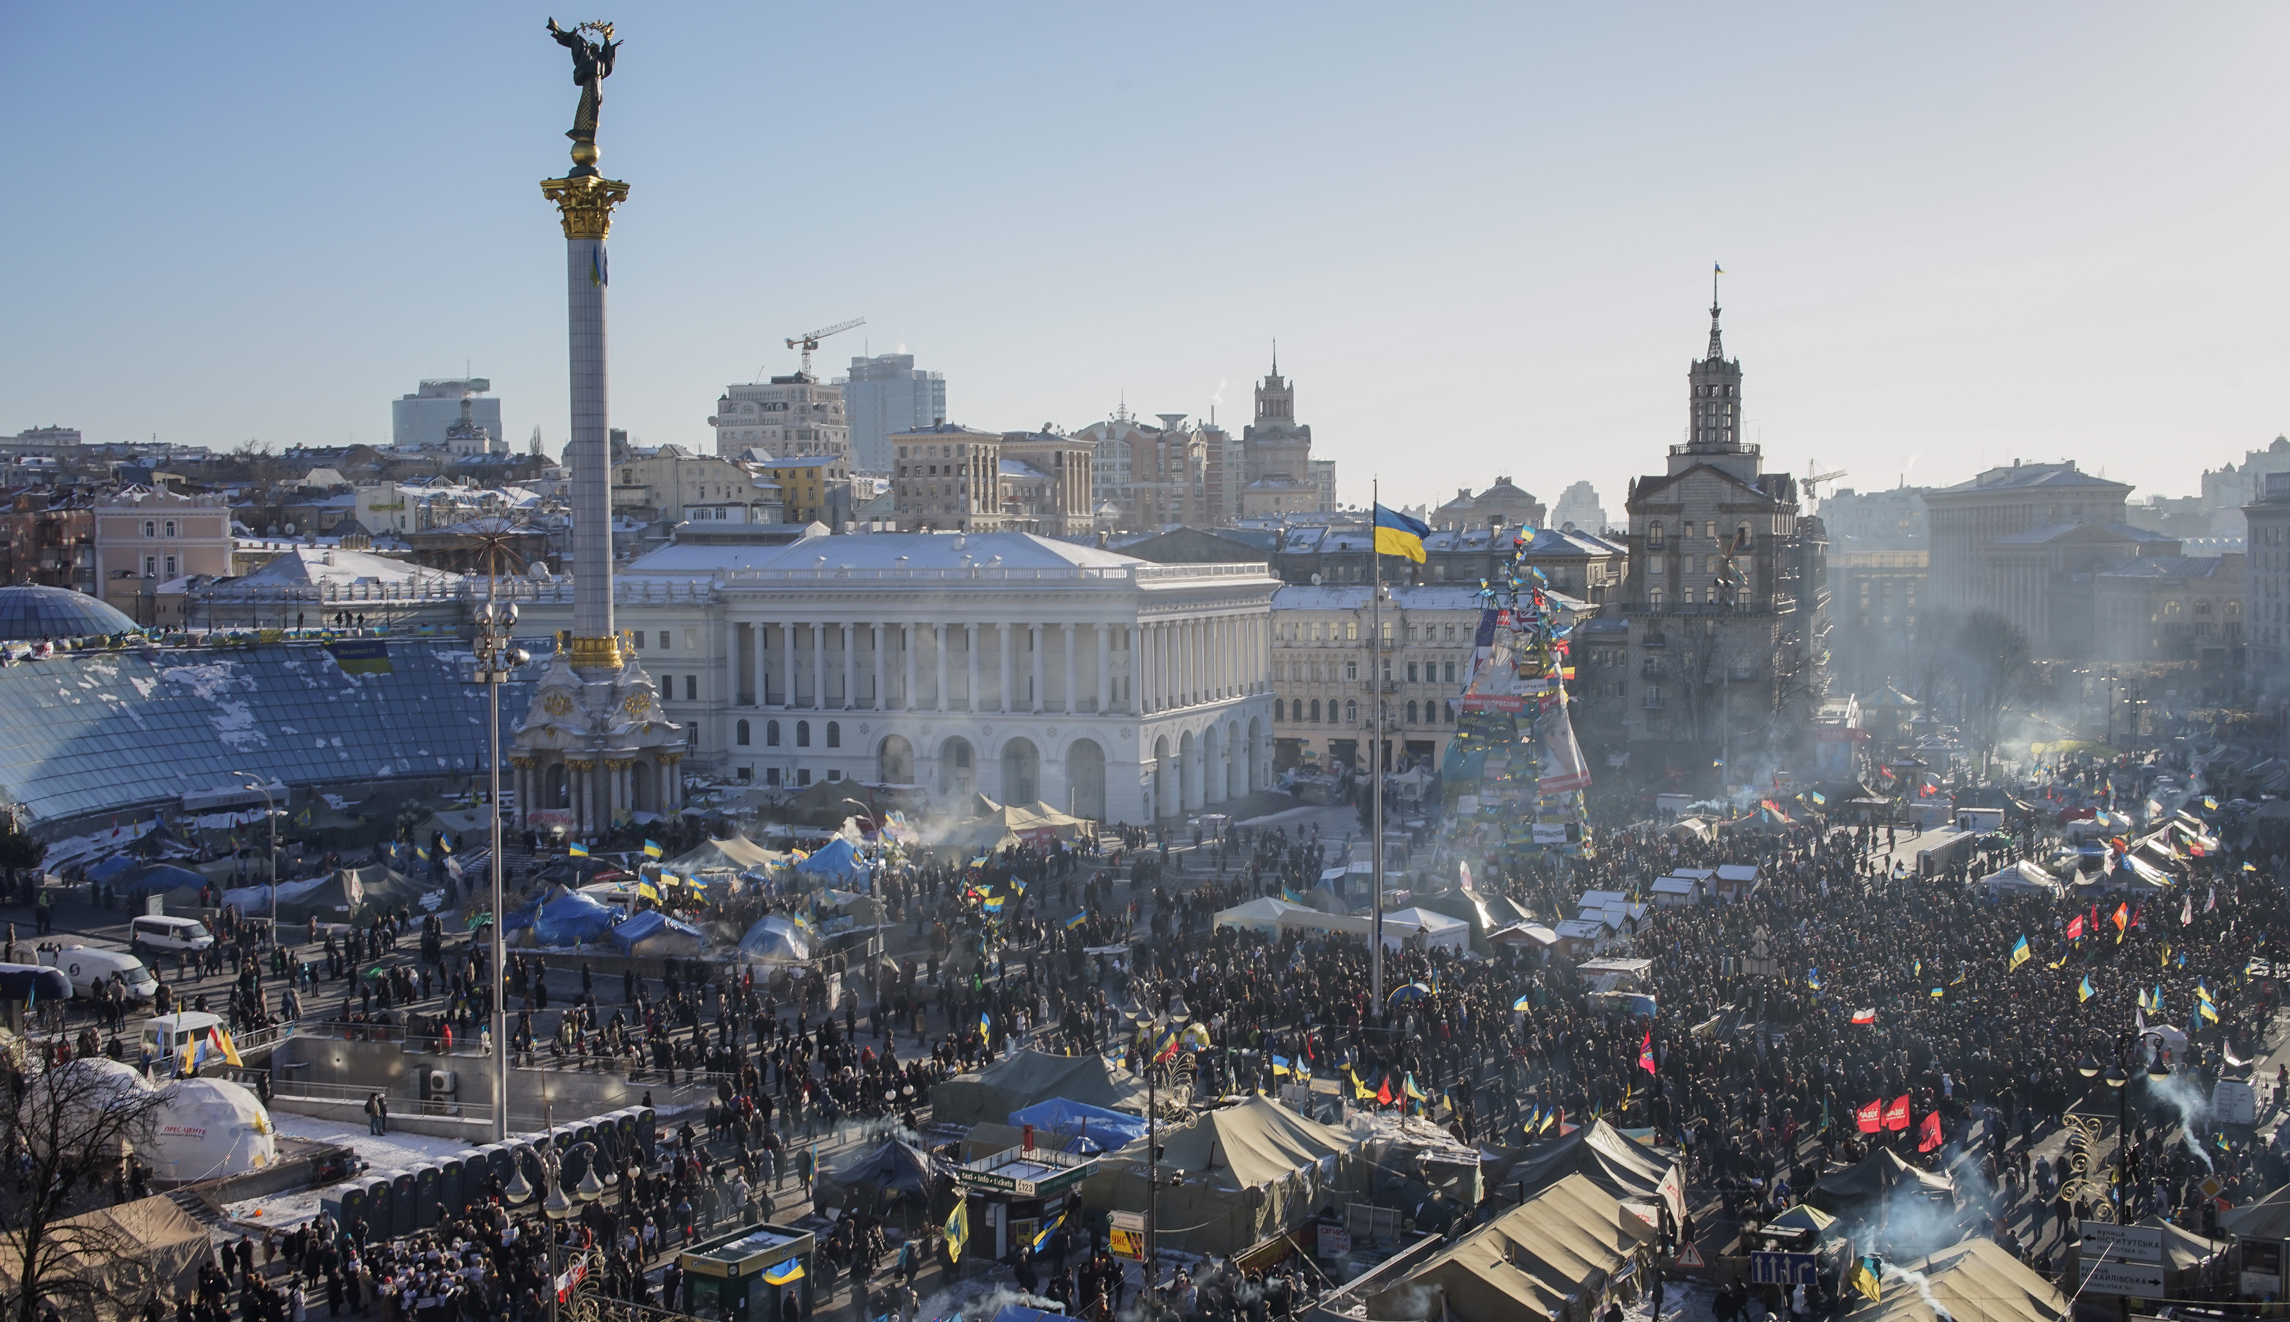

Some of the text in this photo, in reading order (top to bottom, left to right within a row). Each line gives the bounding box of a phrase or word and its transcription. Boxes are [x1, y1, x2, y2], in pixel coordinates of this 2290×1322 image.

[961, 1172, 1014, 1188] taxi info tickets
[1021, 1183, 1033, 1192] 123
[2097, 1229, 2125, 1237] вулиця
[2097, 1236, 2160, 1249] ІНСТИТУТСЬКА
[2097, 1245, 2136, 1254] INSYTUTSKA
